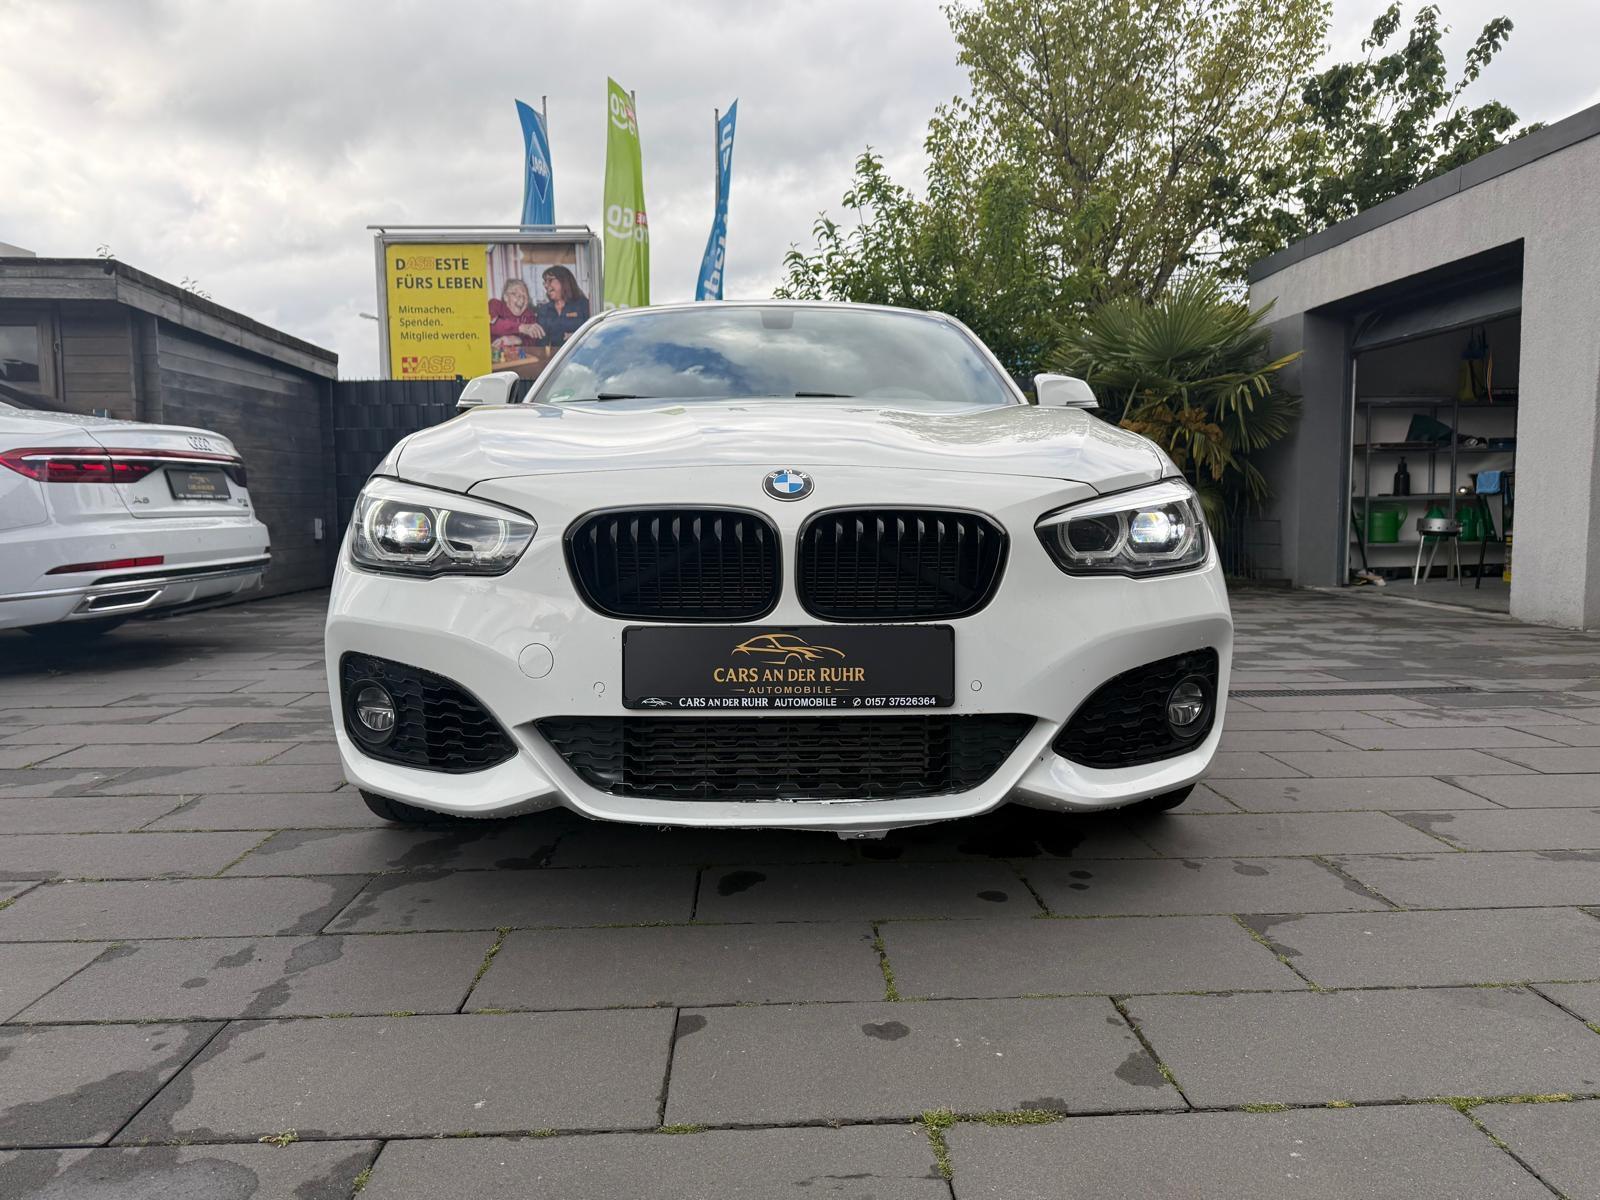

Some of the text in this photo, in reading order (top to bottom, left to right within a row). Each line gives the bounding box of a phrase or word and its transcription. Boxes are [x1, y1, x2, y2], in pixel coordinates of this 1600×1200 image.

[396, 274, 483, 289] FÜRS LEBEN
[399, 305, 455, 314] Mitmachen.
[400, 317, 444, 328] Spenden.
[400, 331, 480, 342] Mitglied werden.
[416, 355, 456, 374] ASB
[713, 667, 865, 682] CARS AN DER RUHR
[748, 686, 832, 694] AUTOMOBILE
[679, 697, 937, 707] CARS AN DER RUHR AUTOMOBILE 0157 37526364
